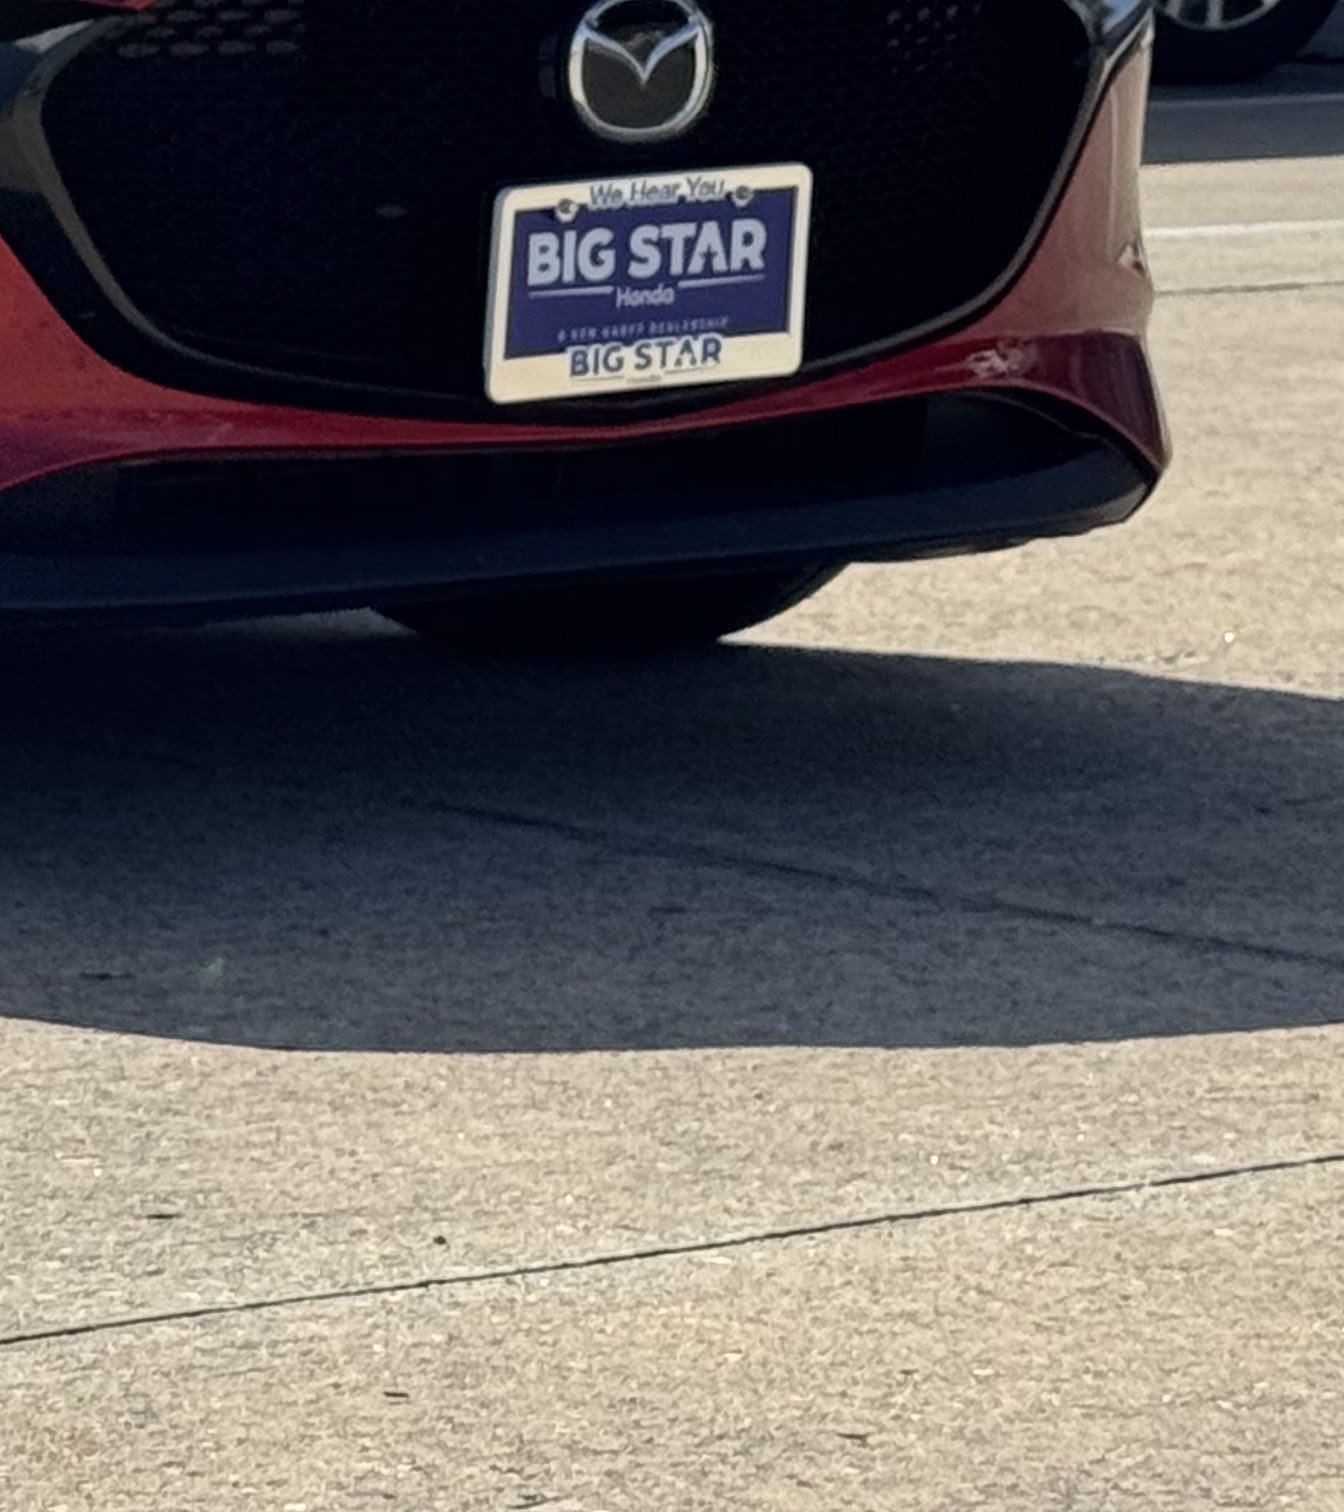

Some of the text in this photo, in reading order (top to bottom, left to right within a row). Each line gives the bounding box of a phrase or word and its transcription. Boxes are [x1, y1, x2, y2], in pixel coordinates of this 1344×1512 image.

[589, 175, 726, 205] We Hear You
[527, 218, 768, 286] BIG STAR
[615, 283, 676, 308] Honda
[569, 338, 723, 378] BIG STAR
